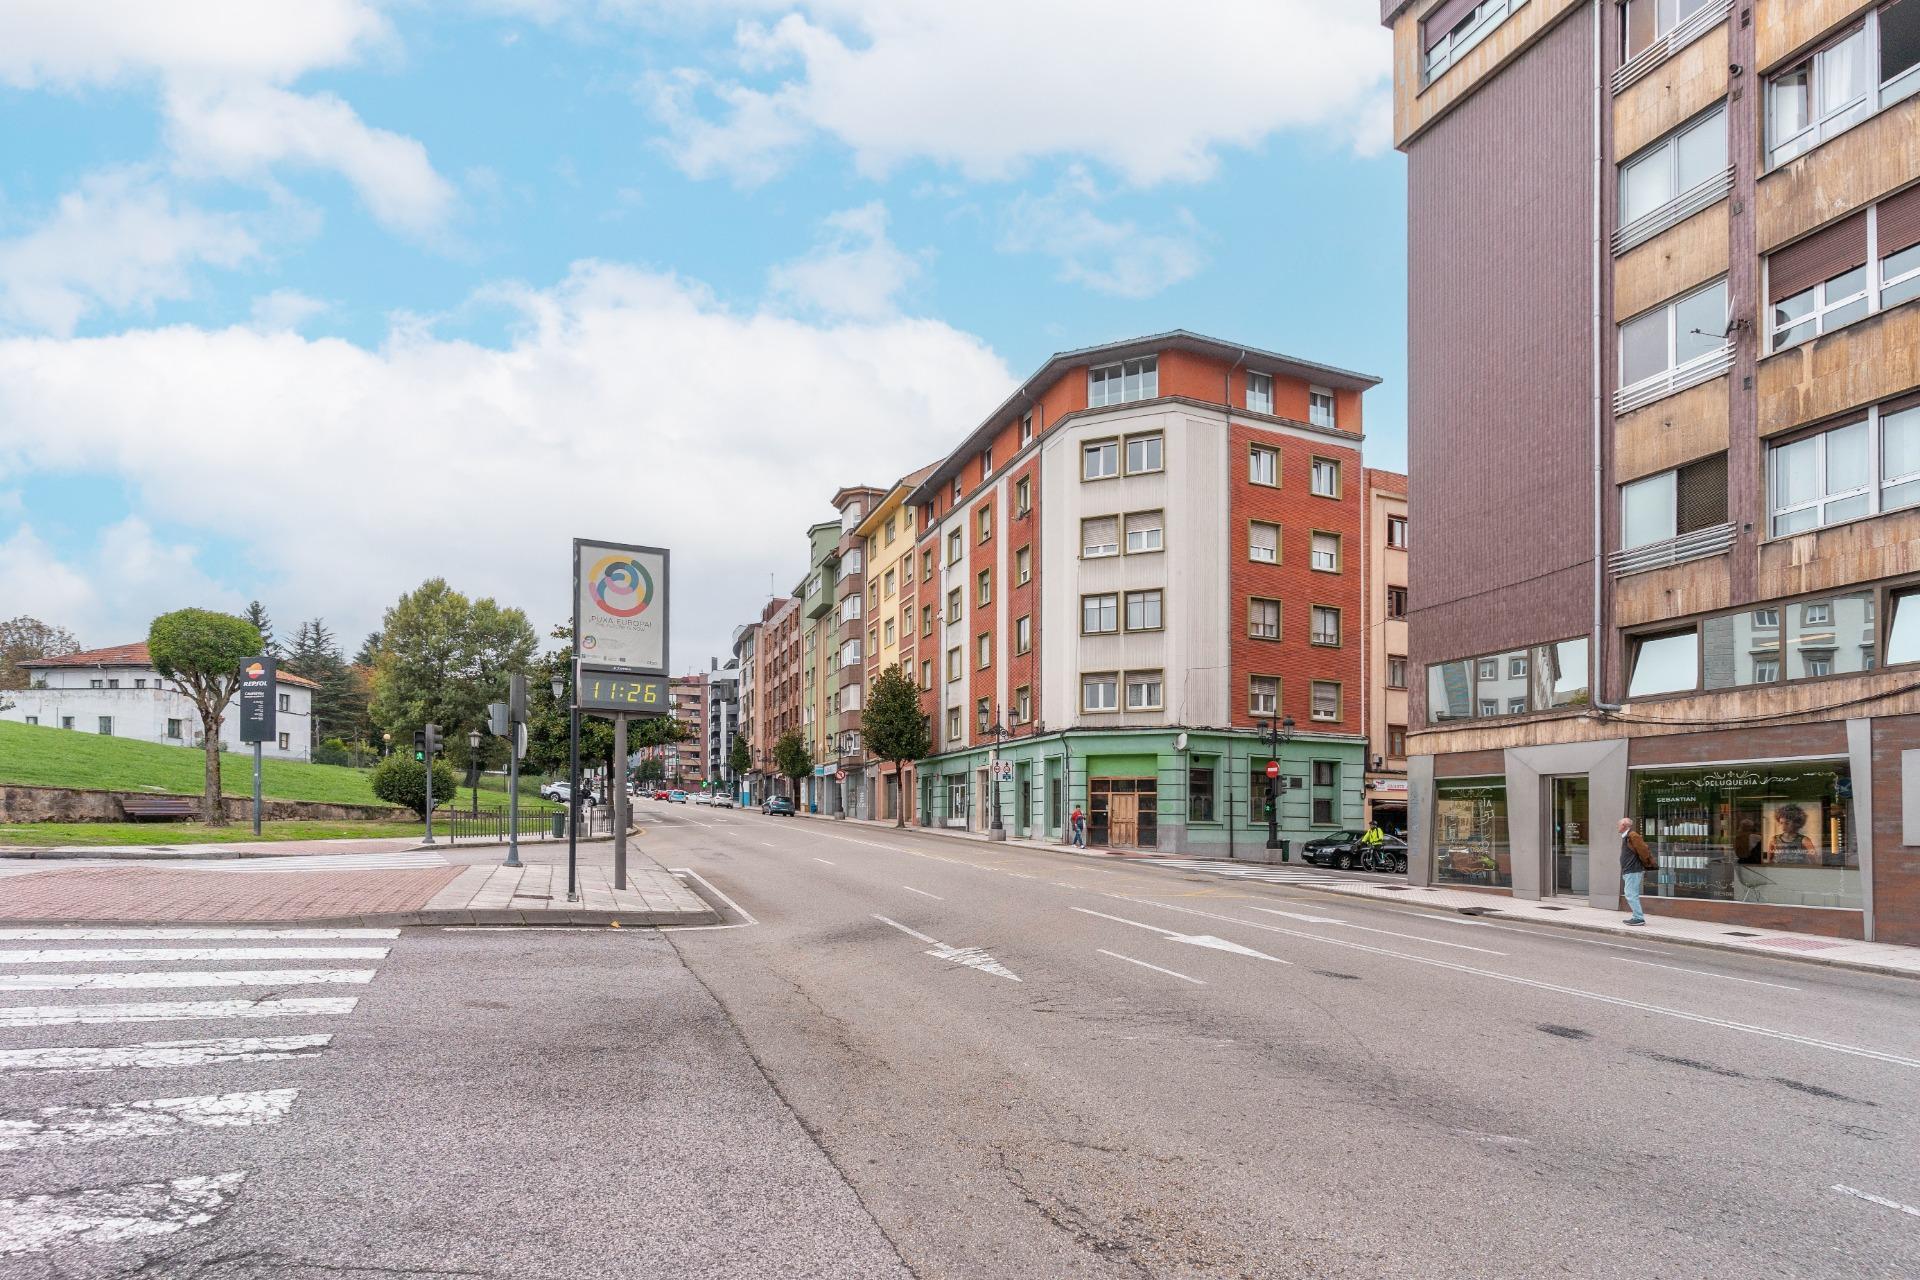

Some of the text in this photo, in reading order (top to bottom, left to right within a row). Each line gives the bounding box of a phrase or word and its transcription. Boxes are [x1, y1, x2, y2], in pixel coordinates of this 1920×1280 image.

[616, 618, 652, 628] EUROPA!
[593, 681, 657, 703] 11:26
[1704, 778, 1758, 788] PELUQUERÍA
